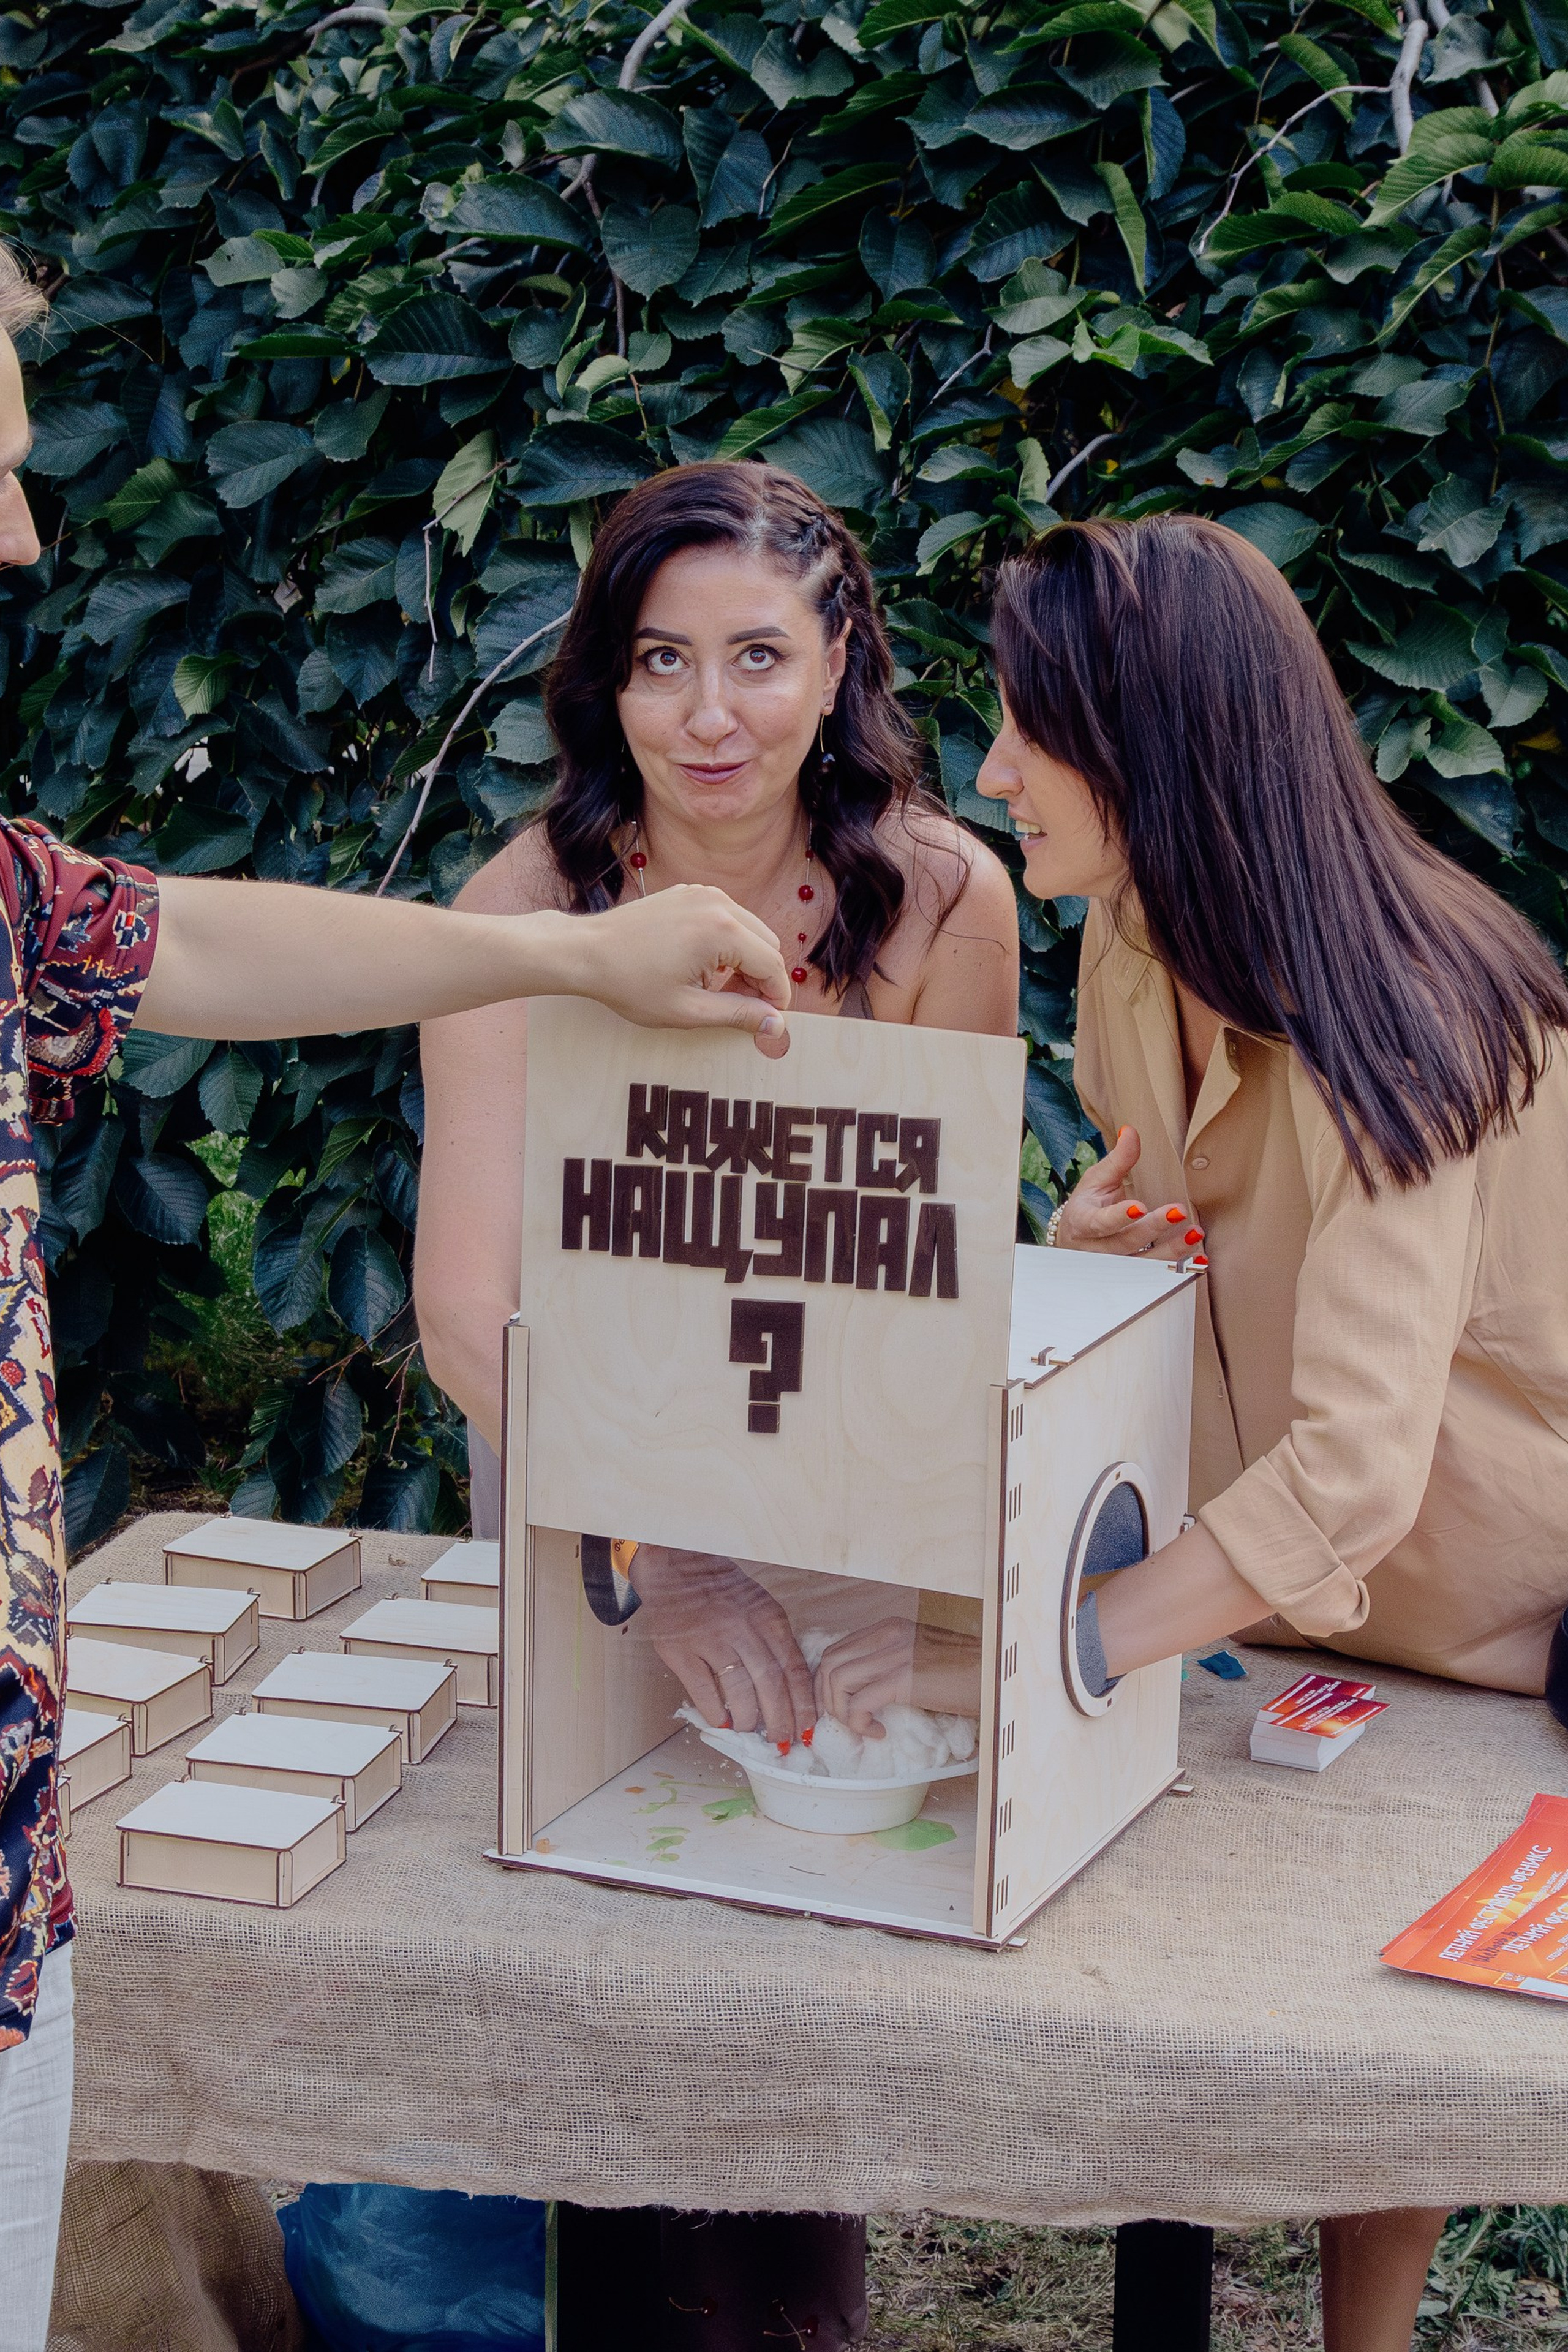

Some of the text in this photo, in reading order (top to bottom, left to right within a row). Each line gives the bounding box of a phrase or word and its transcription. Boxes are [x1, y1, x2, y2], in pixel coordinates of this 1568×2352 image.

[626, 1082, 941, 1194] КАЖЕТСЯ
[562, 1157, 959, 1299] НАЩУПАЛ
[729, 1298, 806, 1434] ?
[1438, 1929, 1483, 1962] ЛЕТНИЙ
[1469, 1884, 1523, 1930] ФЕСТИВАЛЬ
[1510, 1844, 1553, 1883] ФЕНИКС
[1501, 1923, 1555, 1954] ЛЕТНИЙ
